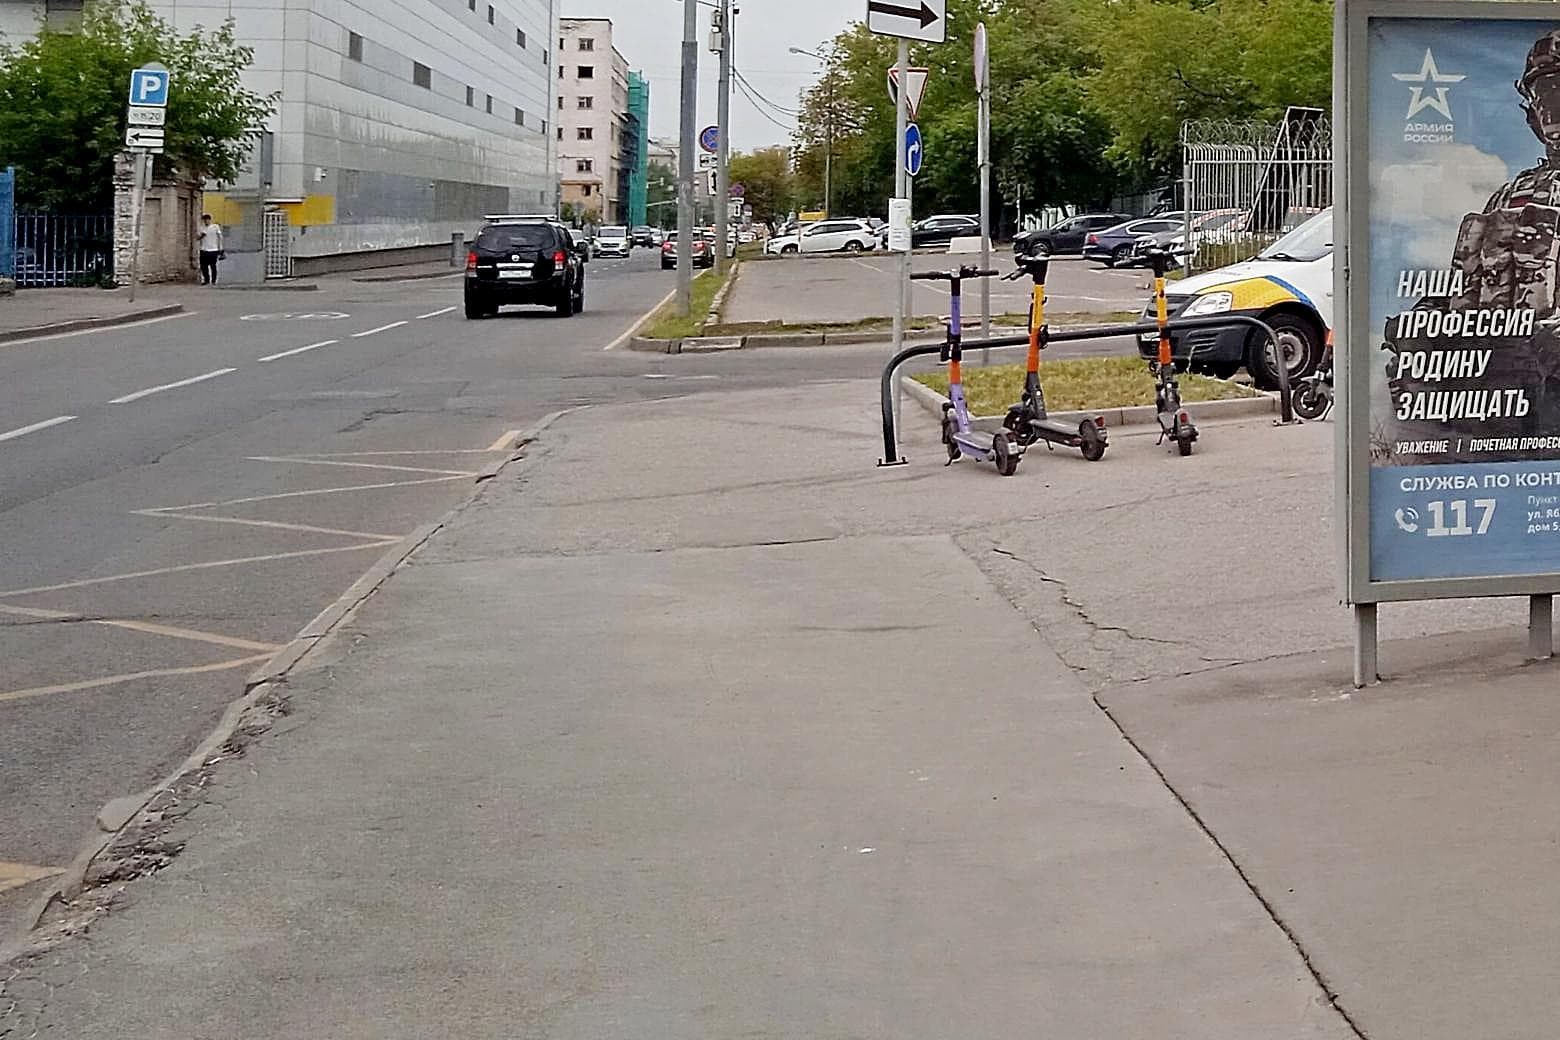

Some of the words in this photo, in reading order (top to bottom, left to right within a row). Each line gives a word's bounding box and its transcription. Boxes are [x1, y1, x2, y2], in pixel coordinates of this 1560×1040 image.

[140, 75, 161, 100] P
[1404, 123, 1454, 133] АРМИЯ
[1404, 134, 1454, 144] РОССИИ
[1396, 269, 1465, 298] НАША
[1396, 308, 1536, 339] ПРОФЕССИЯ
[1396, 349, 1493, 382] РОДИНУ
[1396, 389, 1531, 423] ЗАЩИЩАТЬ
[1395, 440, 1449, 454] УВАЖЕНИЕ
[1469, 438, 1519, 452] ПОЧЕТНАЯ
[1400, 475, 1478, 492] СЛУЖБА
[1484, 474, 1510, 488] ПО
[1527, 495, 1558, 507] Пункт
[1426, 497, 1497, 537] 117
[1527, 511, 1544, 521] ул.
[1527, 523, 1551, 534] дом
